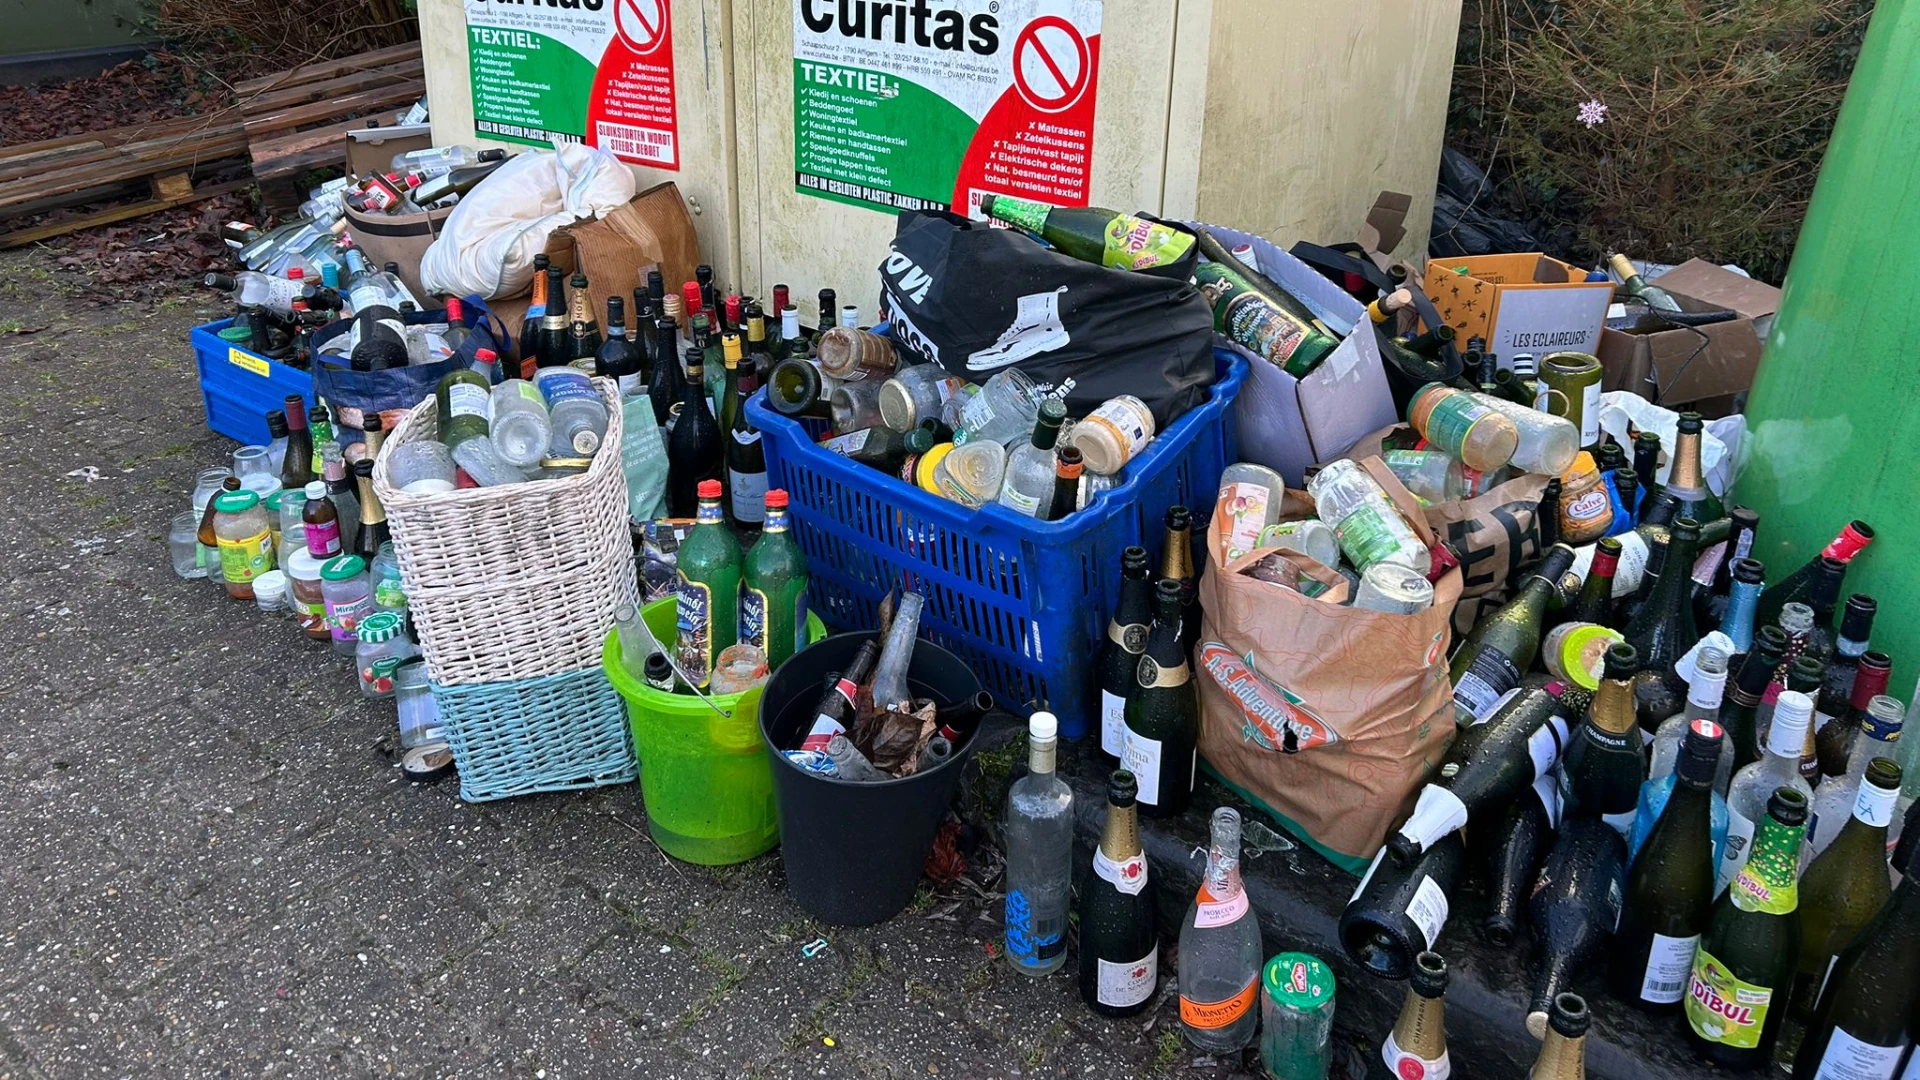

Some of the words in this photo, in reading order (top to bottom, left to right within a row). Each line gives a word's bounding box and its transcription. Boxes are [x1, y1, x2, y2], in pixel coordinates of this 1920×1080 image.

[801, 0, 998, 55] Curitas
[471, 28, 540, 49] TEXTIEL:
[628, 72, 669, 83] Zetelkussens
[636, 63, 669, 73] Matrassen
[613, 90, 647, 100] Elektrische
[648, 95, 671, 104] dekens
[624, 101, 654, 111] besmeurd
[809, 88, 829, 100] Kledij
[842, 95, 878, 108] schoenen
[810, 100, 854, 114] Beddengoed
[810, 110, 858, 126] Woningtextiel
[599, 124, 646, 142] SLUIKSTORTEN
[810, 121, 836, 132] Keuken
[848, 126, 908, 146] badkamertextiel
[1038, 122, 1086, 138] Matrassen
[611, 139, 634, 153] STEEDS
[810, 132, 836, 143] Riemen
[848, 138, 892, 154] handtassen
[1024, 132, 1085, 150] Zetelkussens
[810, 142, 876, 162] Speelgoedknuffels
[1002, 141, 1058, 159] Tapijten/vast
[1061, 151, 1084, 164] tapijt
[810, 153, 837, 167] Propere
[839, 157, 864, 170] lappen
[865, 164, 888, 175] textiel
[998, 152, 1048, 168] Elektrische
[1050, 162, 1083, 175] dekens
[810, 162, 833, 174] Textiel
[834, 169, 848, 177] met
[849, 172, 866, 181] klein
[868, 175, 892, 187] defect
[993, 163, 1010, 174] Nat.
[1013, 167, 1057, 182] besmeurd
[1059, 177, 1083, 188] en/of
[800, 173, 818, 188] ALLES
[820, 178, 828, 190] IN
[829, 180, 862, 199] GESLOTEN
[863, 187, 893, 206] PLASTIC
[894, 194, 922, 211] ZAKKEN
[985, 174, 1009, 185] totaal
[1011, 179, 1052, 194] versleten
[1054, 186, 1082, 199] textiel
[1513, 333, 1530, 348] LES
[1532, 331, 1586, 347] ECLAIREURS
[1585, 725, 1626, 746] CHAMPAGNE
[1193, 999, 1242, 1018] MIONETTO
